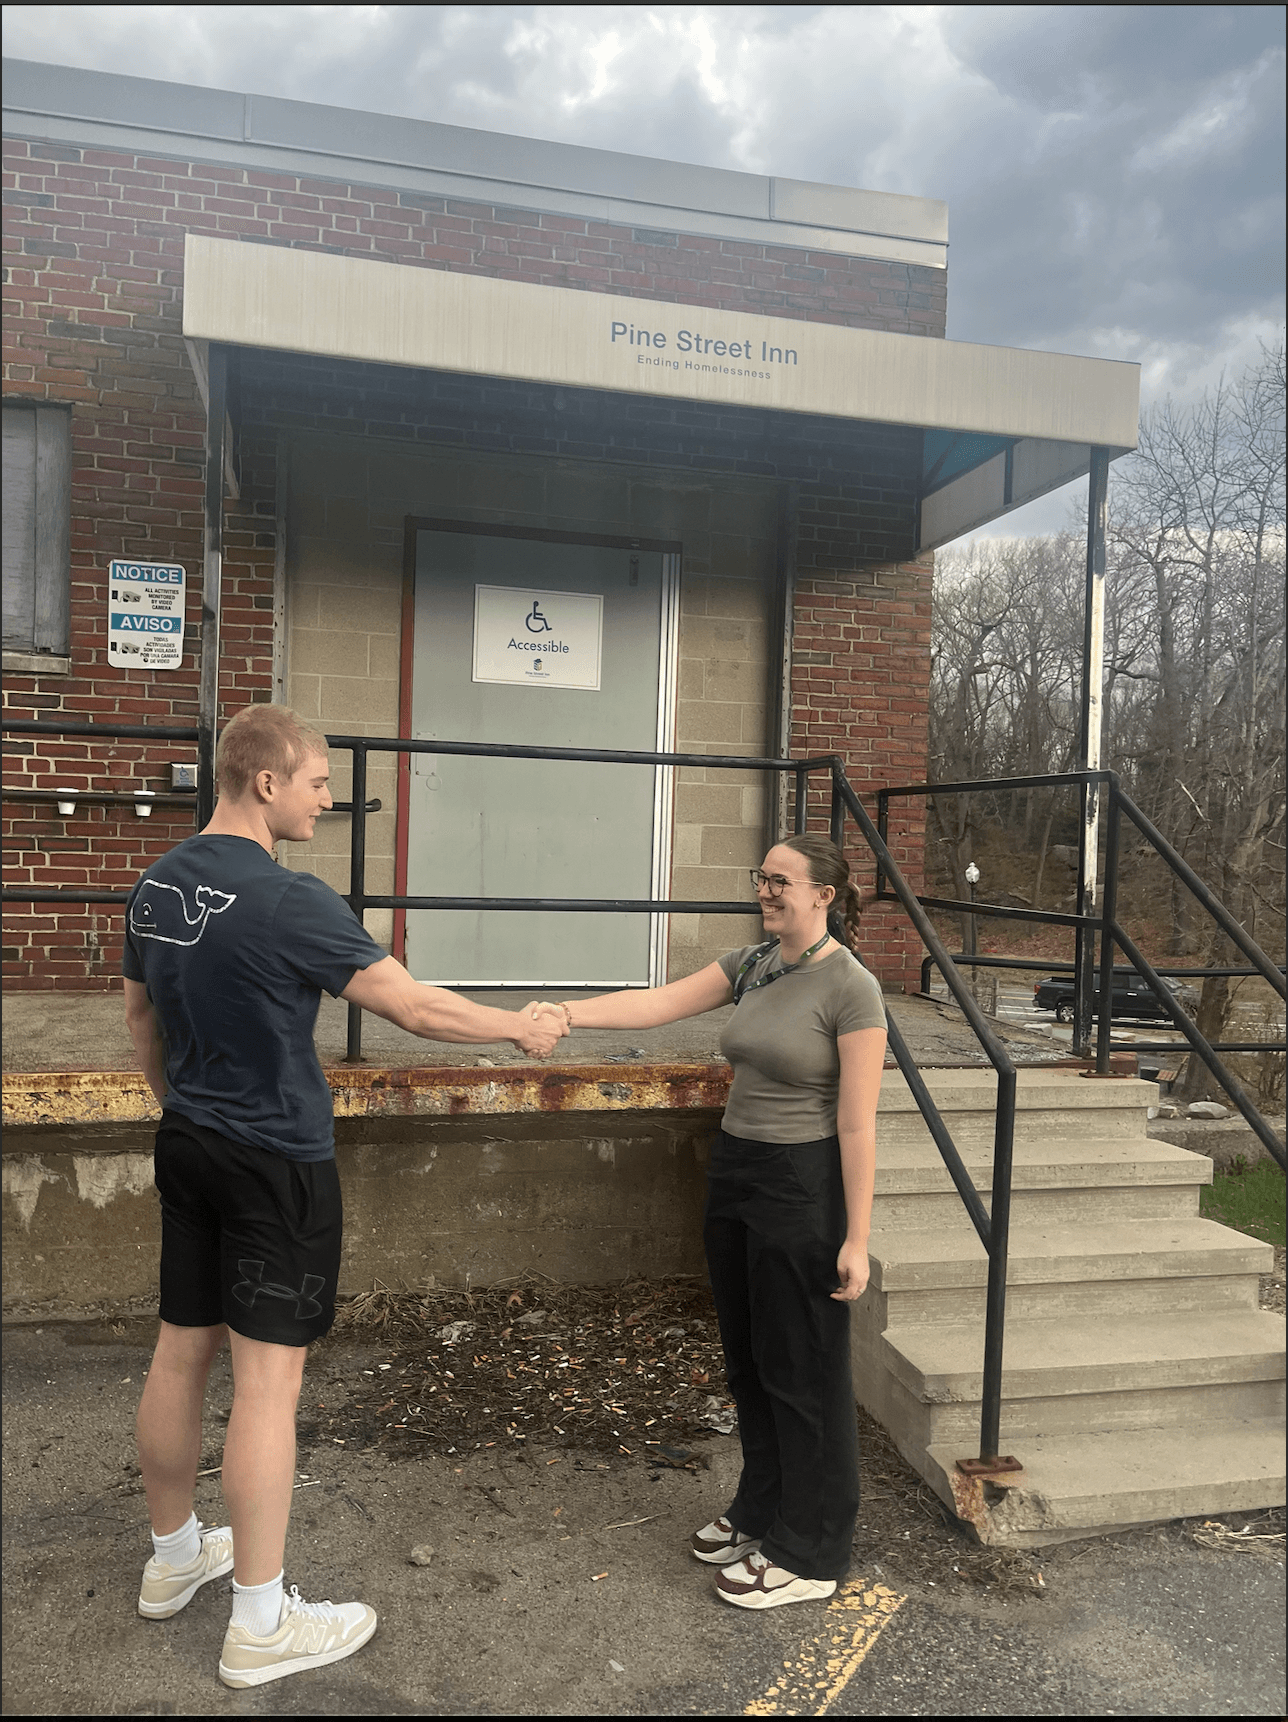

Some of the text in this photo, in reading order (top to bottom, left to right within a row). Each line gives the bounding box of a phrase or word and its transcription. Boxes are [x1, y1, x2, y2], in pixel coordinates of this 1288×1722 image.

[610, 321, 798, 365] Pine Street Inn
[637, 354, 771, 380] Ending Homelessness
[116, 565, 179, 582] NOTICE
[120, 616, 173, 631] AVISO
[507, 637, 570, 654] Accessible
